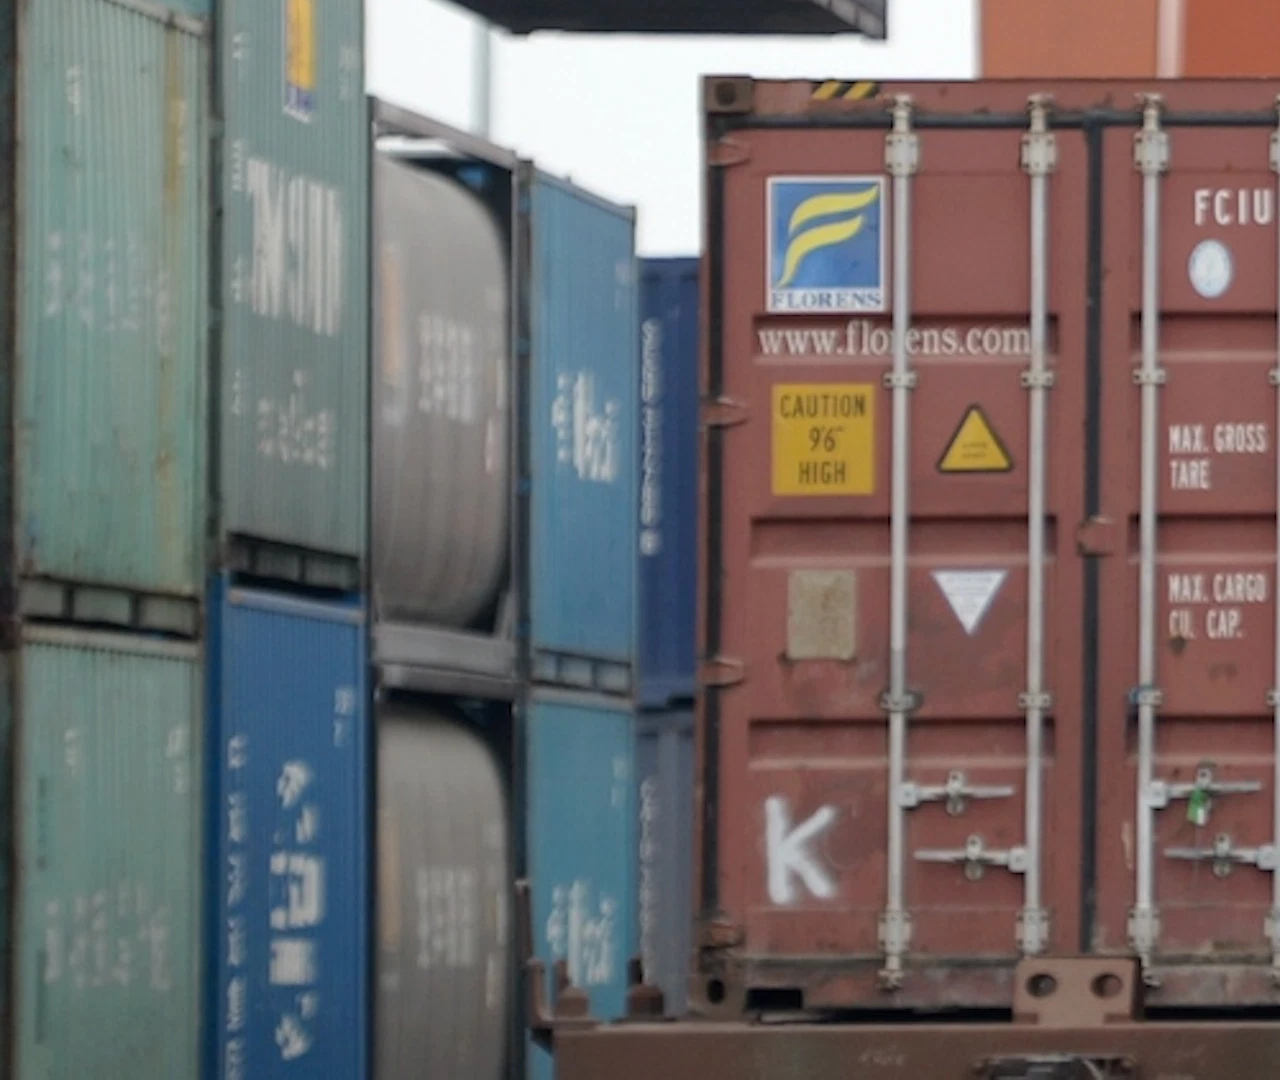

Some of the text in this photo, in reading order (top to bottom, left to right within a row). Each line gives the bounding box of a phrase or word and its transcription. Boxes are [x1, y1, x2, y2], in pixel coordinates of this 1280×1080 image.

[1193, 188, 1273, 226] FCIU
[771, 291, 882, 309] FLORENS
[757, 320, 1031, 356] www.floens.com
[780, 393, 866, 419] CAUTION
[1168, 422, 1267, 454] MAX. GROSS
[798, 460, 847, 486] HIGH
[1169, 458, 1210, 490] TARE
[1168, 572, 1267, 603] MAX. CARGO
[1206, 608, 1243, 639] CAP.
[765, 796, 836, 905] K
